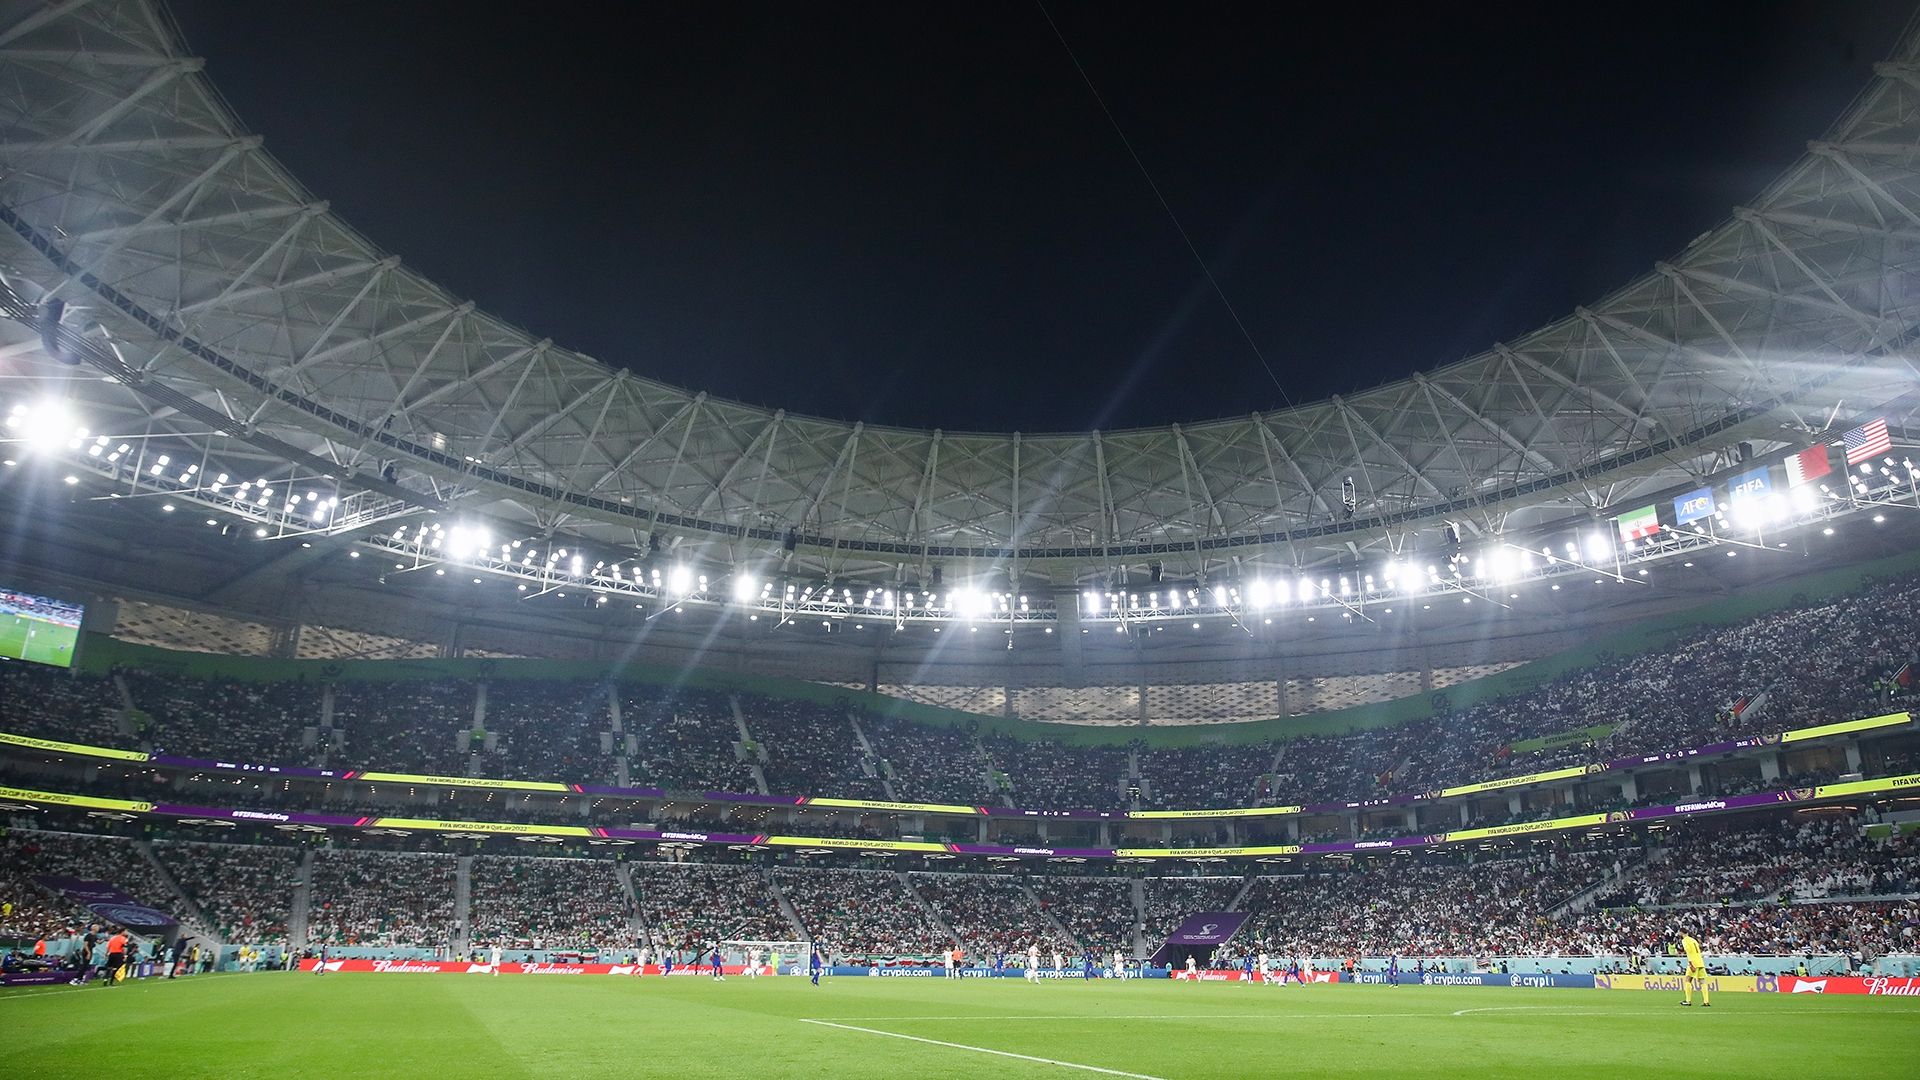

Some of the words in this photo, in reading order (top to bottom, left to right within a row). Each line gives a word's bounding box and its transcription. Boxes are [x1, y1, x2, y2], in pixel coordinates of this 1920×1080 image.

[1736, 478, 1765, 496] FIFA
[1680, 497, 1708, 516] AFC
[1674, 801, 1726, 812] #FIFAWorldCup
[372, 960, 440, 972] Budweiser
[521, 962, 585, 974] Budweiser
[881, 968, 932, 977] crypto.com
[1036, 970, 1084, 978] crypo.com
[1433, 974, 1482, 985] crypto.com
